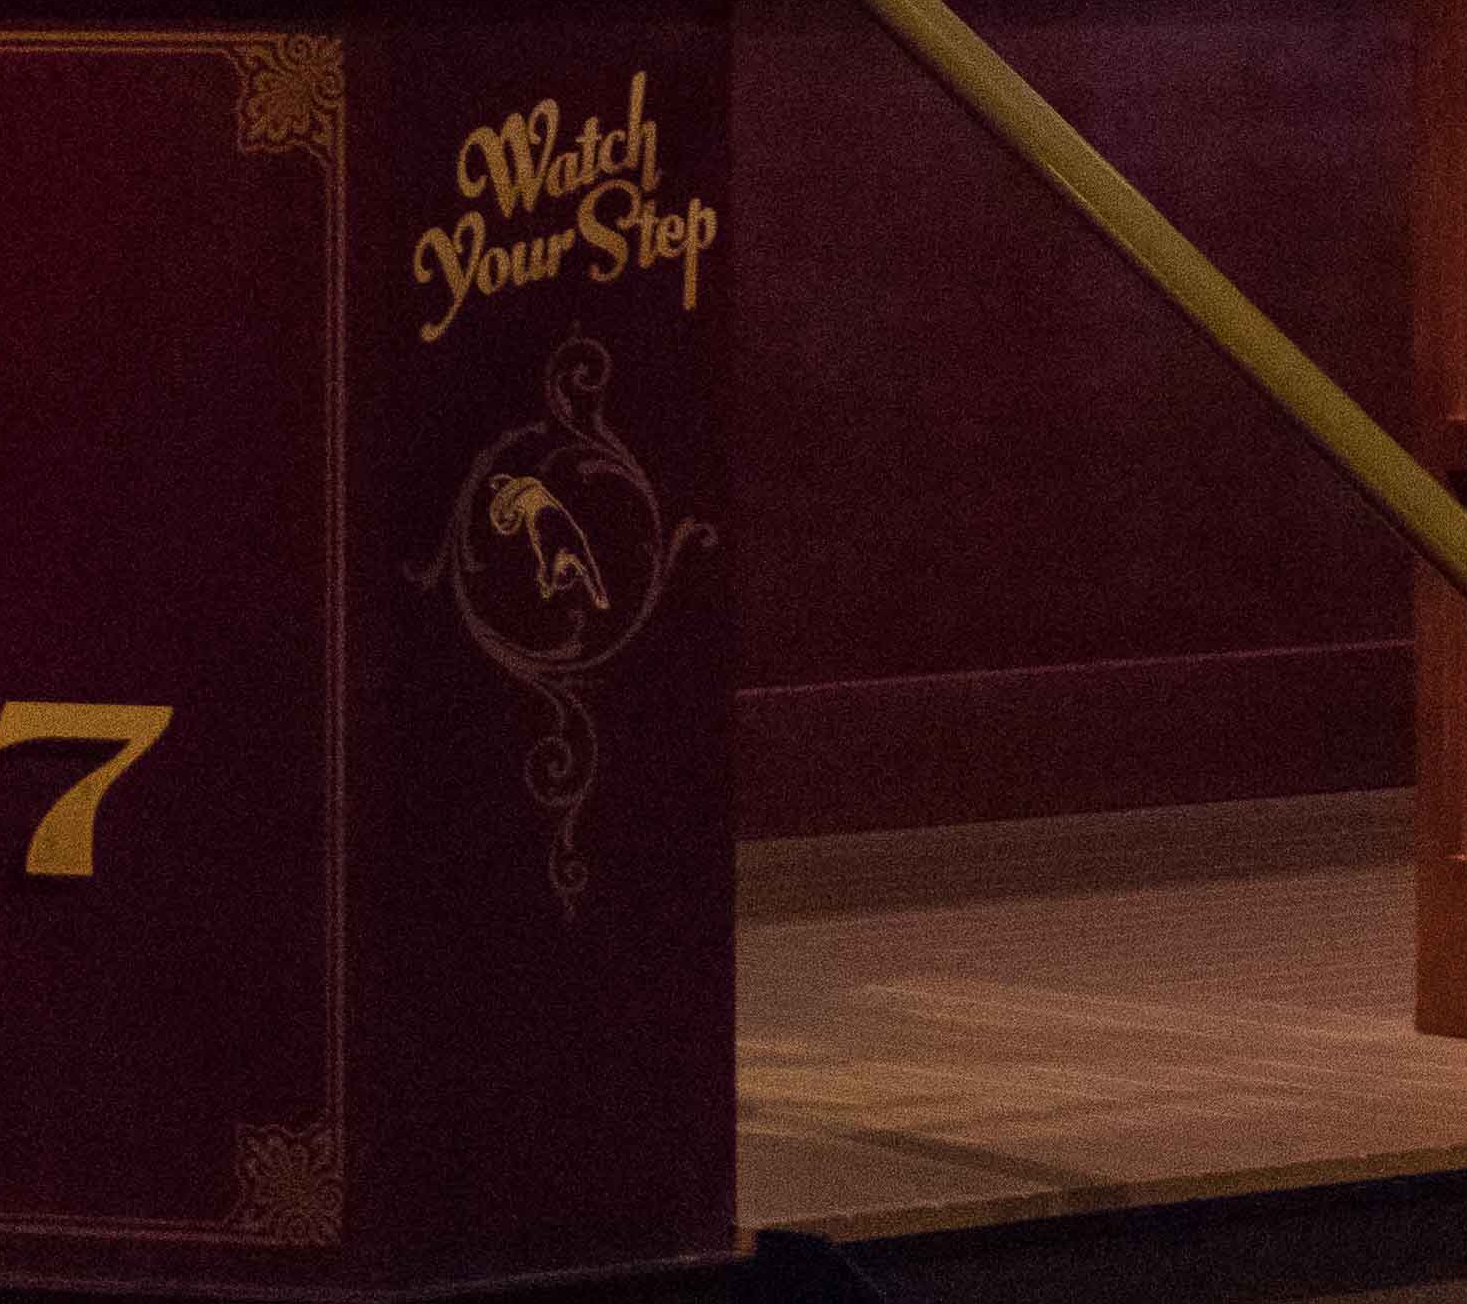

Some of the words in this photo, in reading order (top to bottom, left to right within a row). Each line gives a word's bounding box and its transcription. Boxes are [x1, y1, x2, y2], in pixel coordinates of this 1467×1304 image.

[456, 70, 664, 221] Watch
[412, 210, 576, 344] Your
[576, 178, 719, 313] Step
